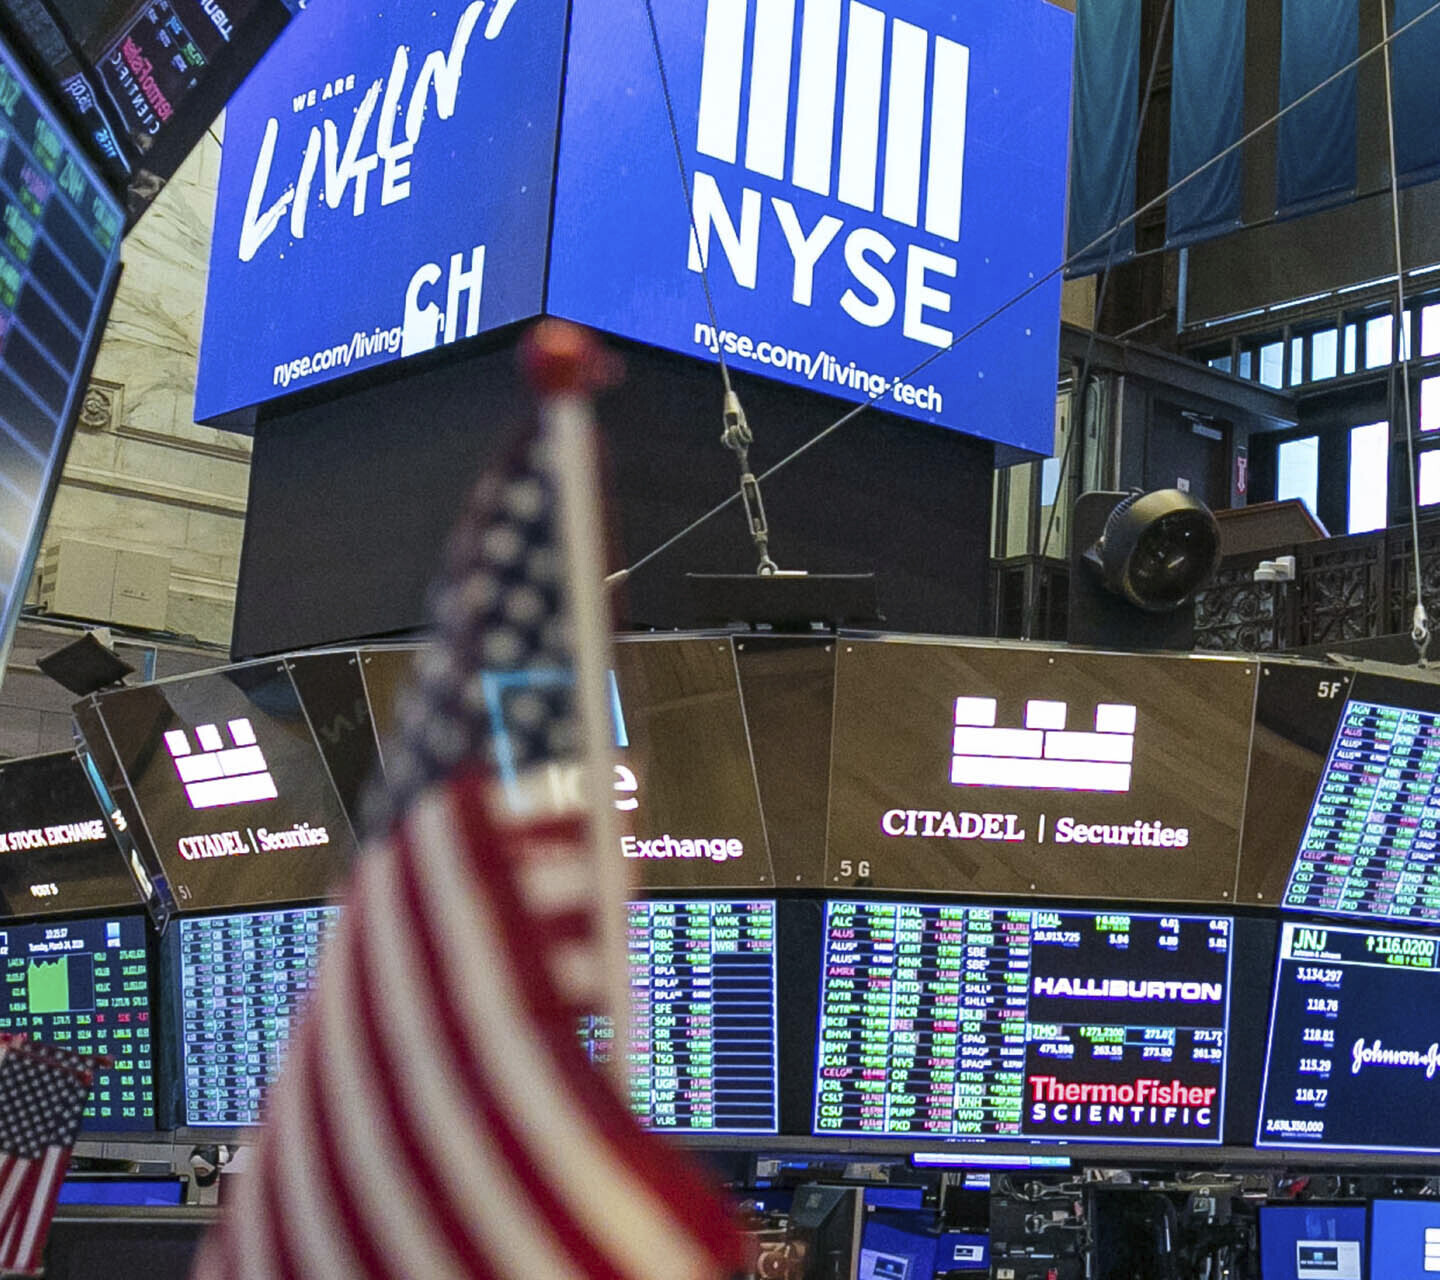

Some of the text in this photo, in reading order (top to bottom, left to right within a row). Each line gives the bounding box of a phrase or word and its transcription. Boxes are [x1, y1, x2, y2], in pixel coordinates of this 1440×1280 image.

[293, 74, 356, 113] WE ARE
[687, 171, 958, 348] NYSE
[694, 321, 943, 414] nyse.com/living-tech
[1317, 681, 1340, 699] 5F
[9, 827, 46, 851] STOCK
[46, 819, 106, 846] EXCHANGE
[178, 821, 330, 861] CITADEL Securities
[881, 809, 1189, 848] CITADEL Securities
[621, 835, 743, 862] Exchange
[1294, 929, 1327, 951] JNJ
[1375, 937, 1435, 956] 116.0200
[1033, 977, 1222, 1001] HALLIBURTON
[1030, 1075, 1216, 1106] ThermoFisher
[1033, 1103, 1211, 1125] SCIENTIFIC
